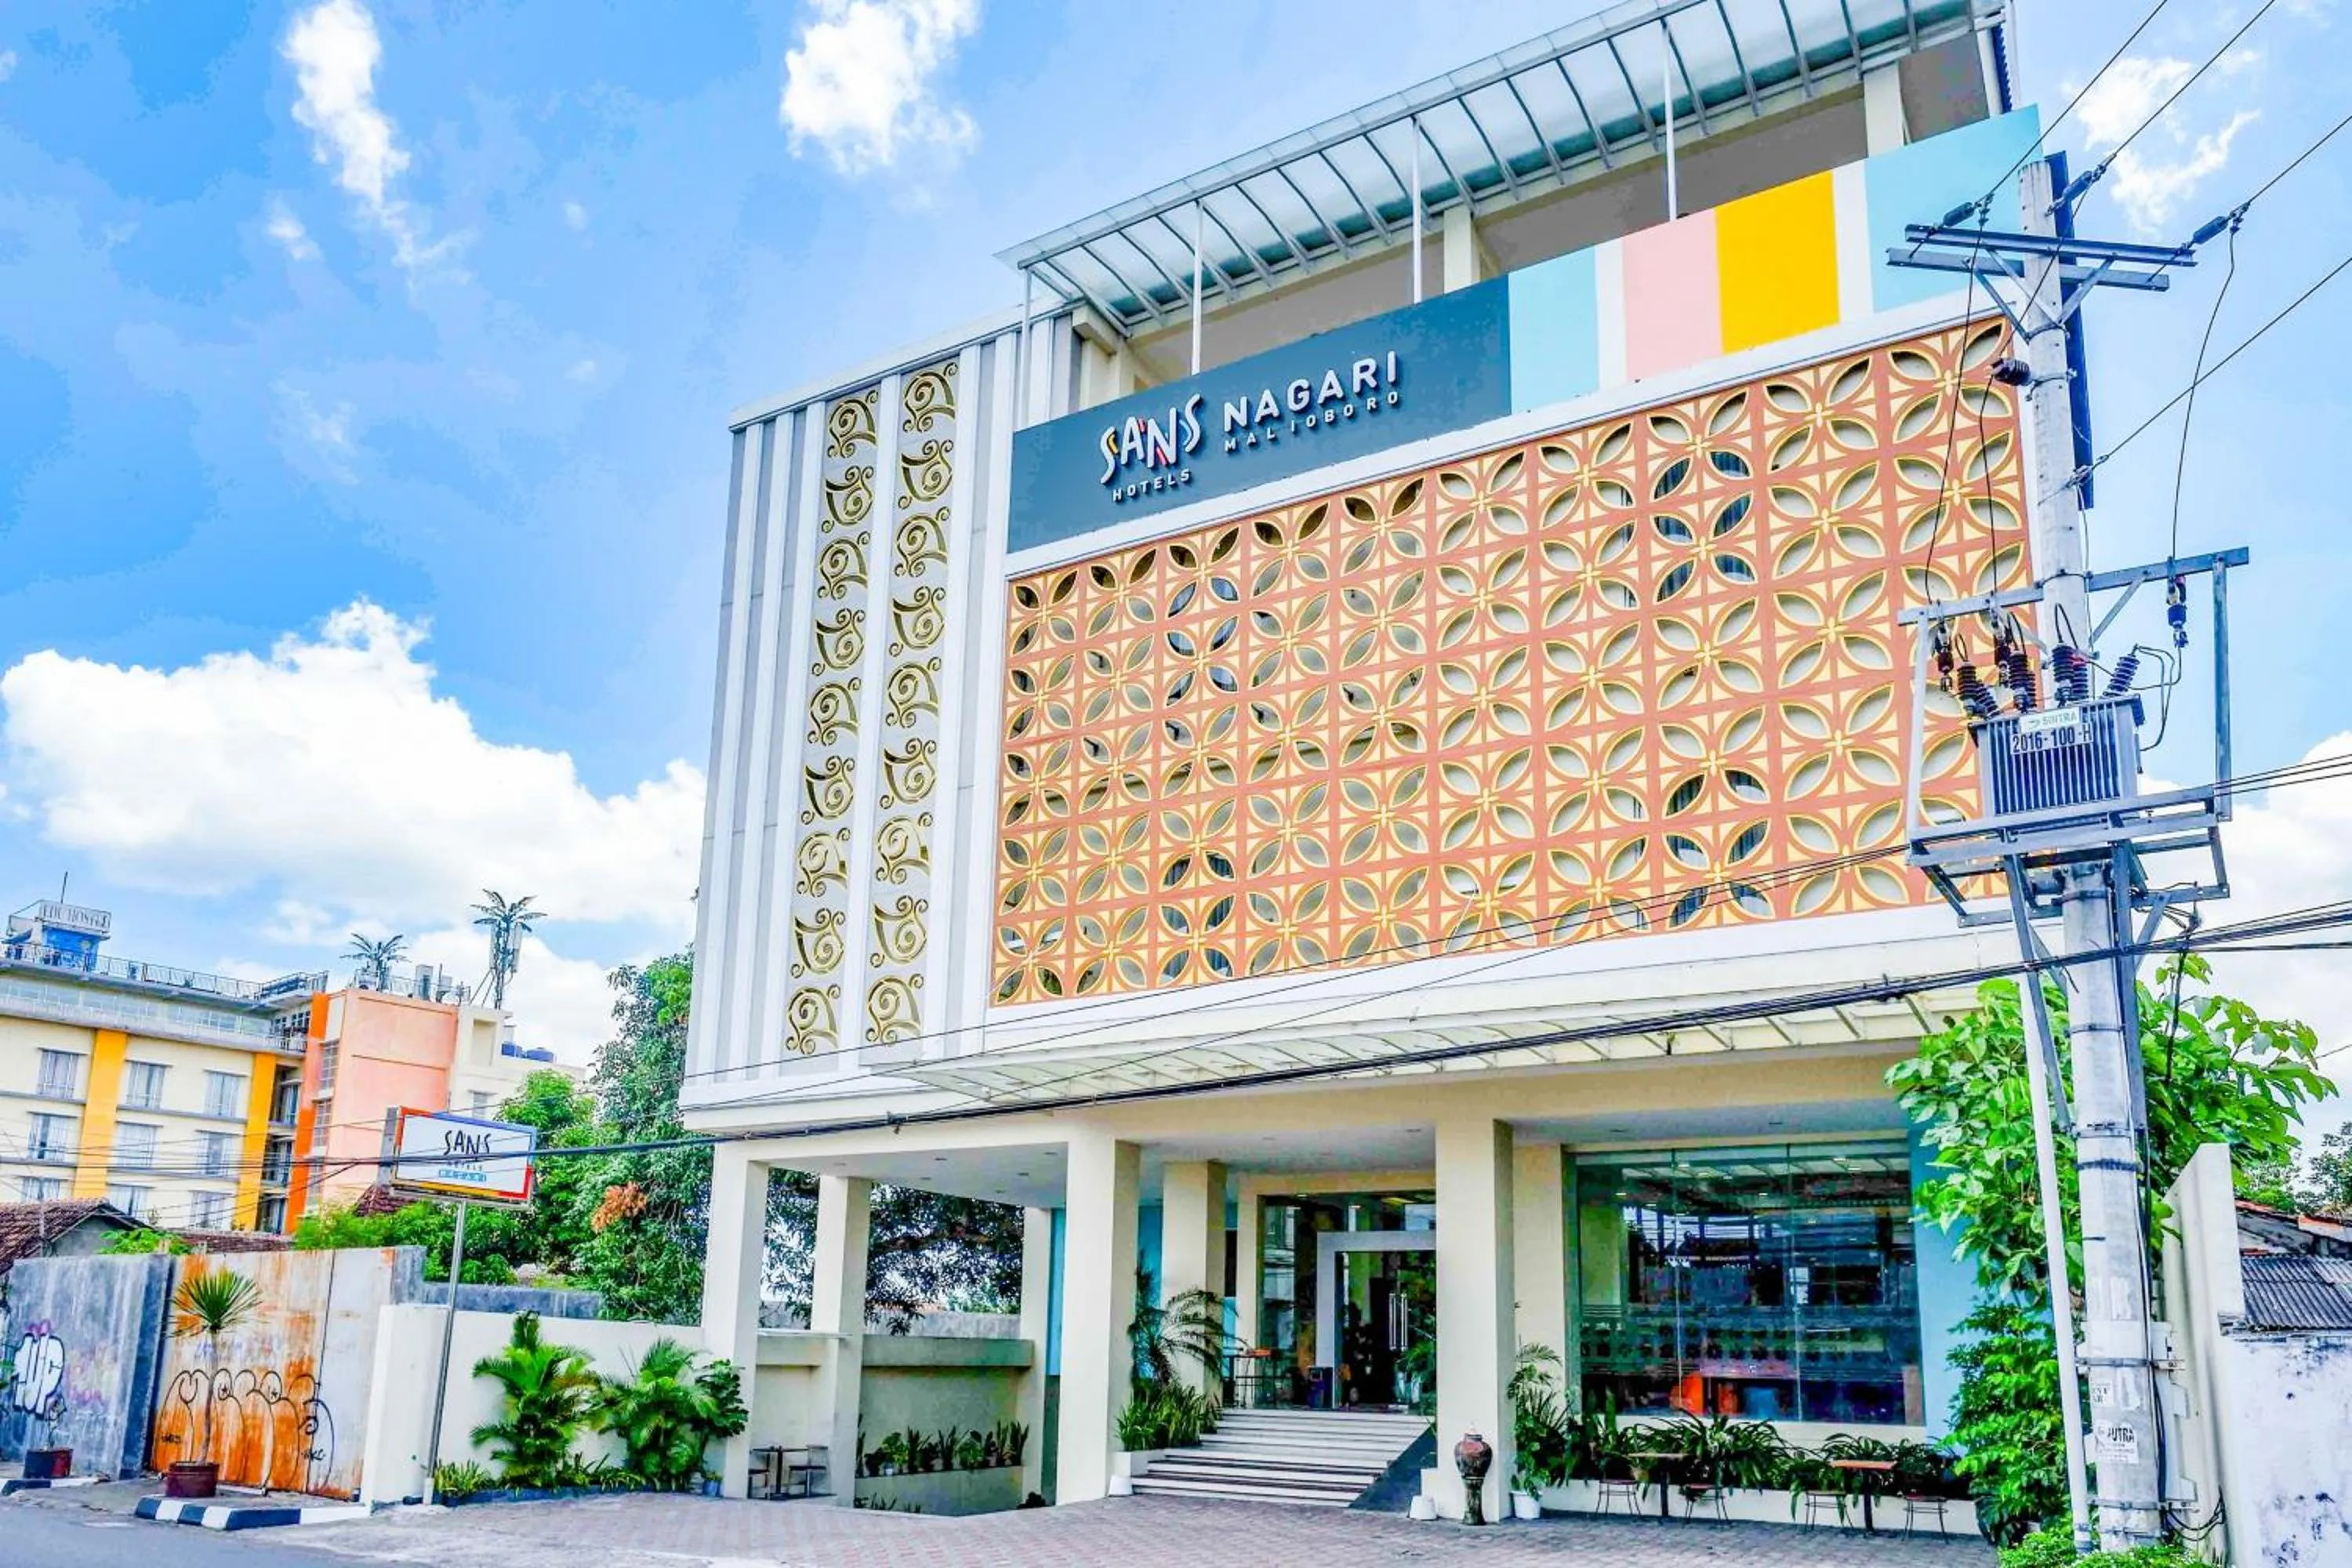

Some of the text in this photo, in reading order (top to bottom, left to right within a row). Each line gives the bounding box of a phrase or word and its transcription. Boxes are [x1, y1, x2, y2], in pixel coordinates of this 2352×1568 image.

[1223, 350, 1397, 433] NAGARI
[1224, 391, 1399, 452] MALIOBORO
[1100, 393, 1203, 485] SANS
[1112, 468, 1192, 503] HOTELS
[443, 1129, 492, 1156] SANS
